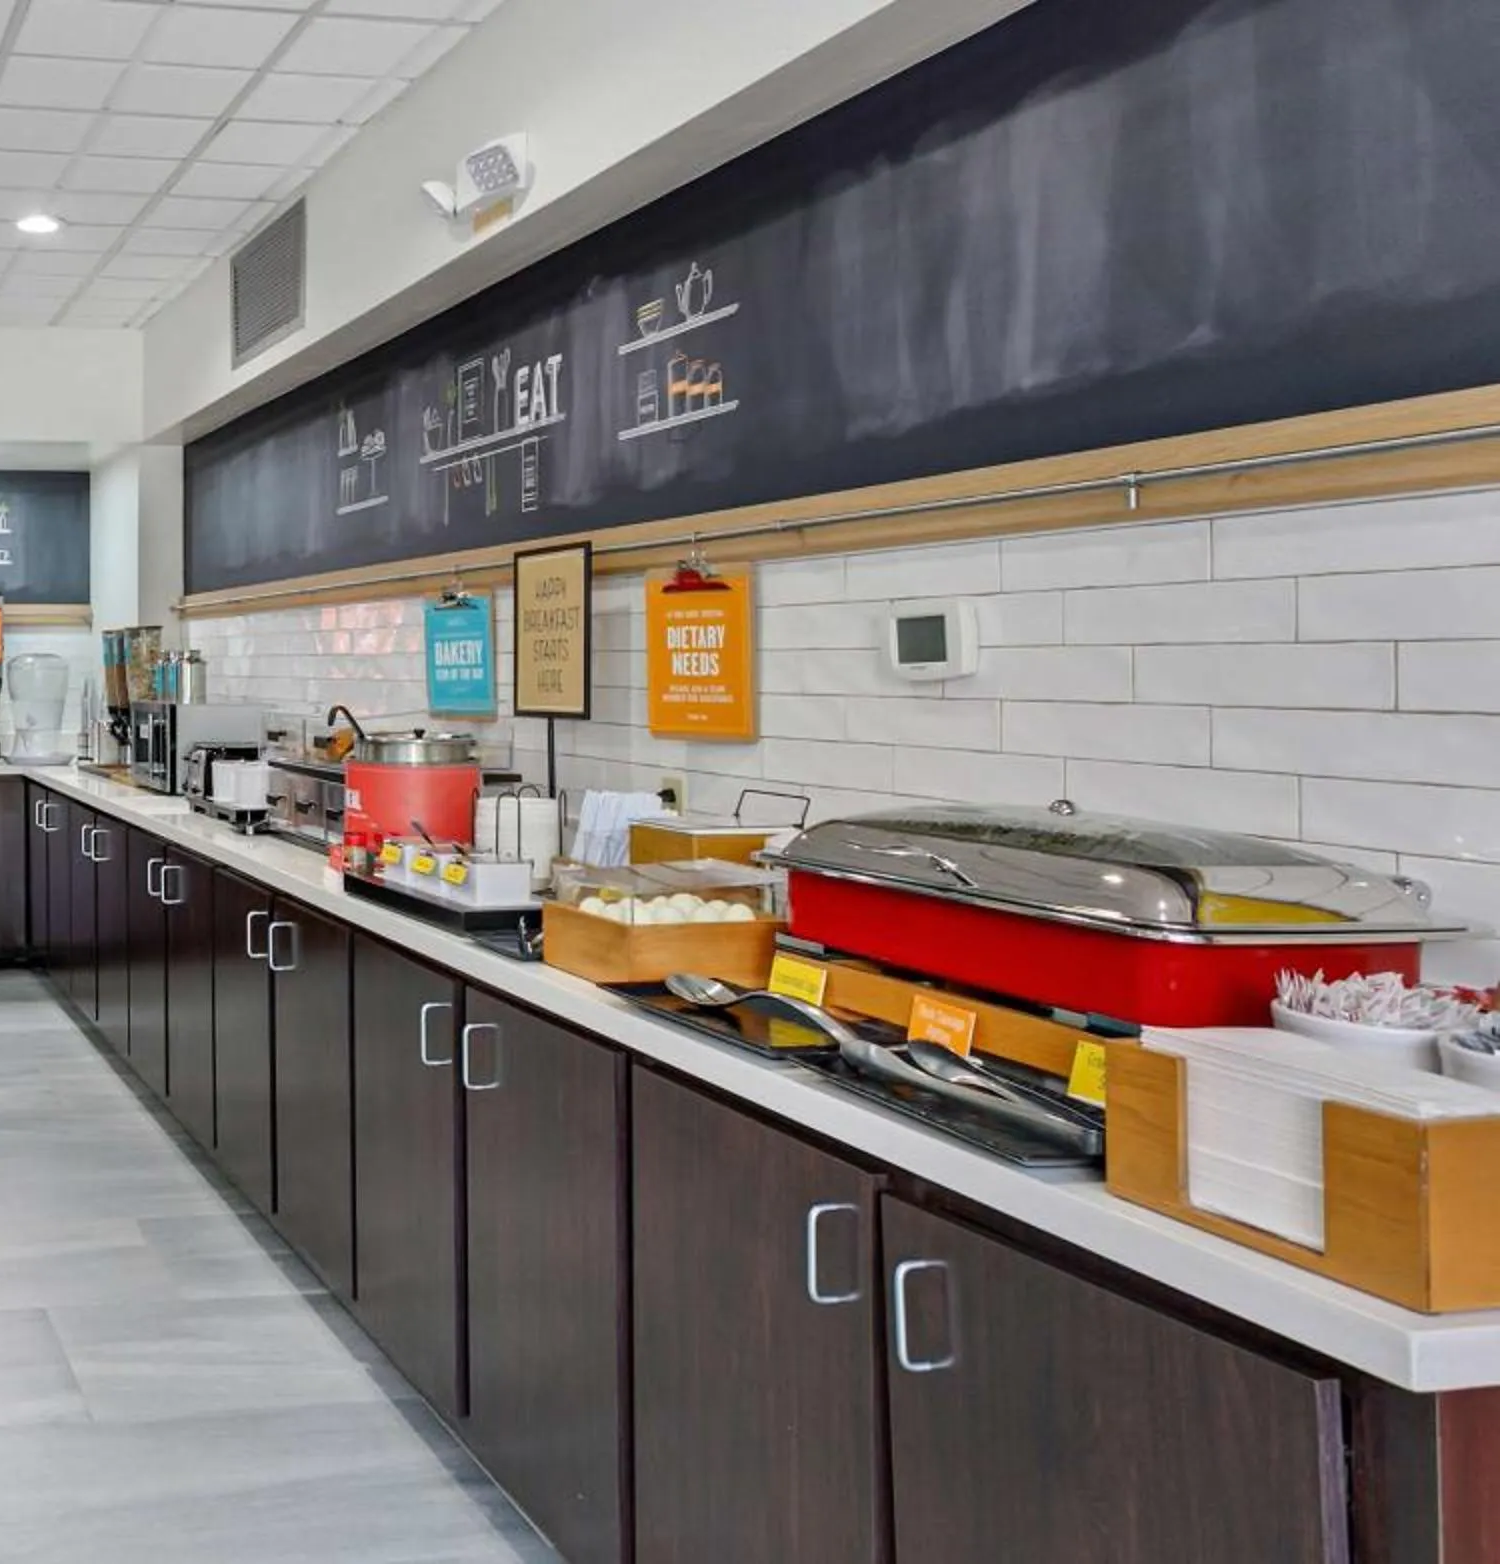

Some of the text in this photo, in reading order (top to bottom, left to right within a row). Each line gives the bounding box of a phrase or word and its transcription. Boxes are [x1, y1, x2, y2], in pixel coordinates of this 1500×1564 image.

[514, 352, 563, 431] EAT
[534, 576, 567, 600] HAPPY
[522, 605, 580, 633] BREAKFAST
[666, 623, 726, 650] DIETARY
[434, 639, 484, 666] BAKERY
[532, 638, 570, 662] STARTS
[671, 652, 720, 677] NEEDS
[536, 668, 564, 693] HERE
